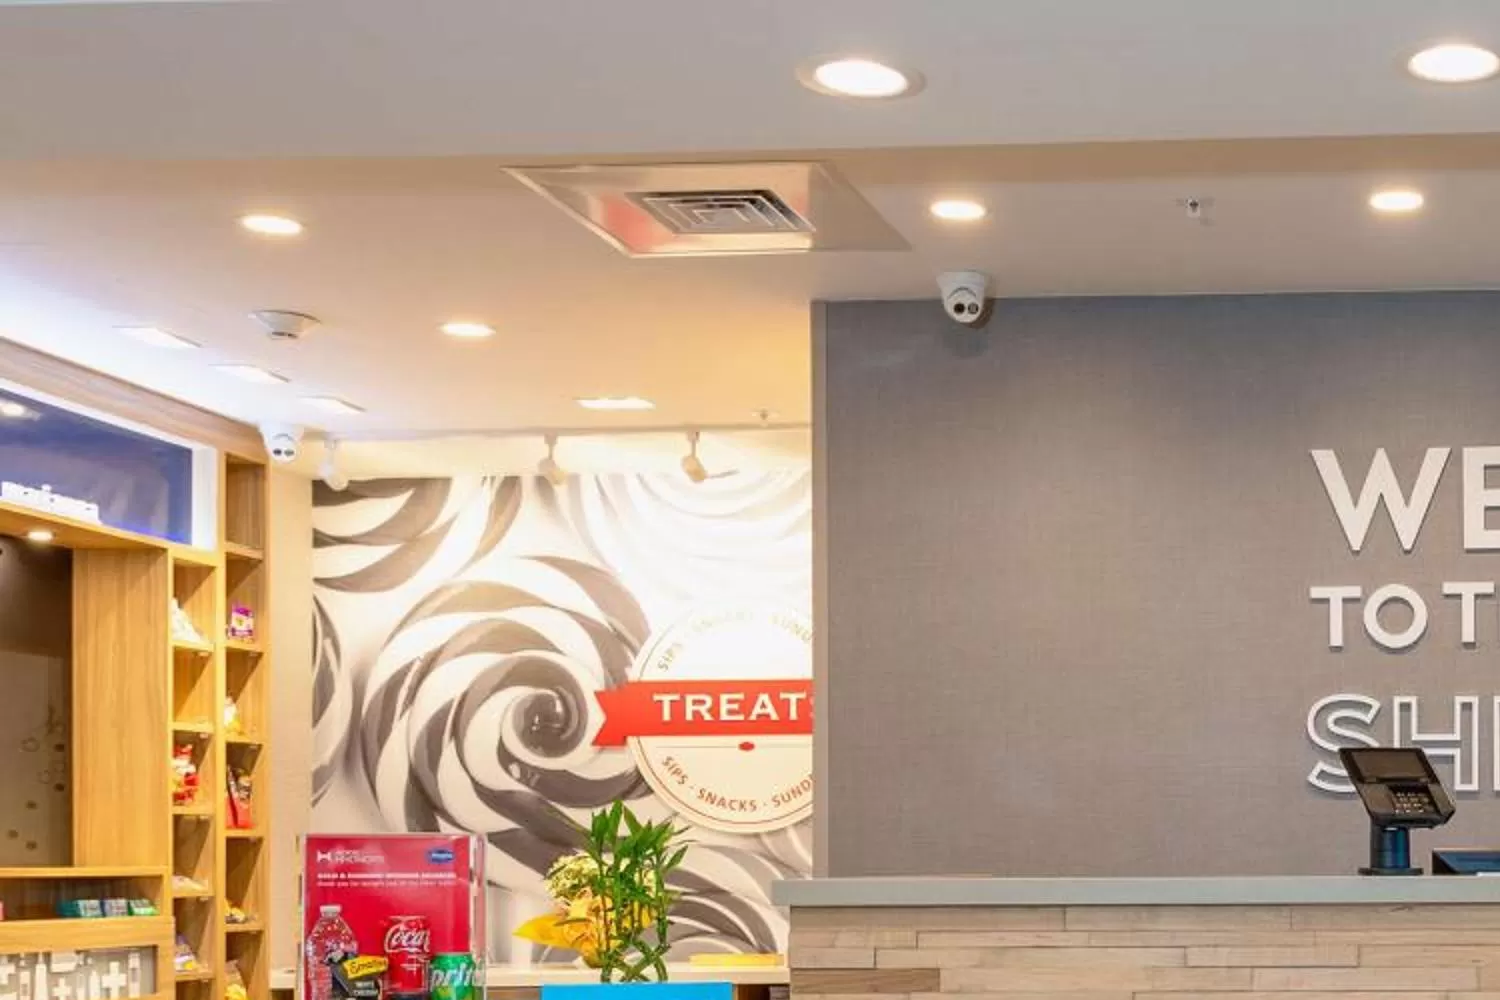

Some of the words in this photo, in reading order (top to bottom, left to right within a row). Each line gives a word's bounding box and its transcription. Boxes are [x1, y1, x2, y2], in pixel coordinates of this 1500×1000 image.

[1309, 583, 1429, 650] TO
[652, 692, 816, 722] TREAT
[661, 755, 689, 785] SIPS
[697, 787, 759, 812] SNACKS
[771, 773, 815, 808] SUND
